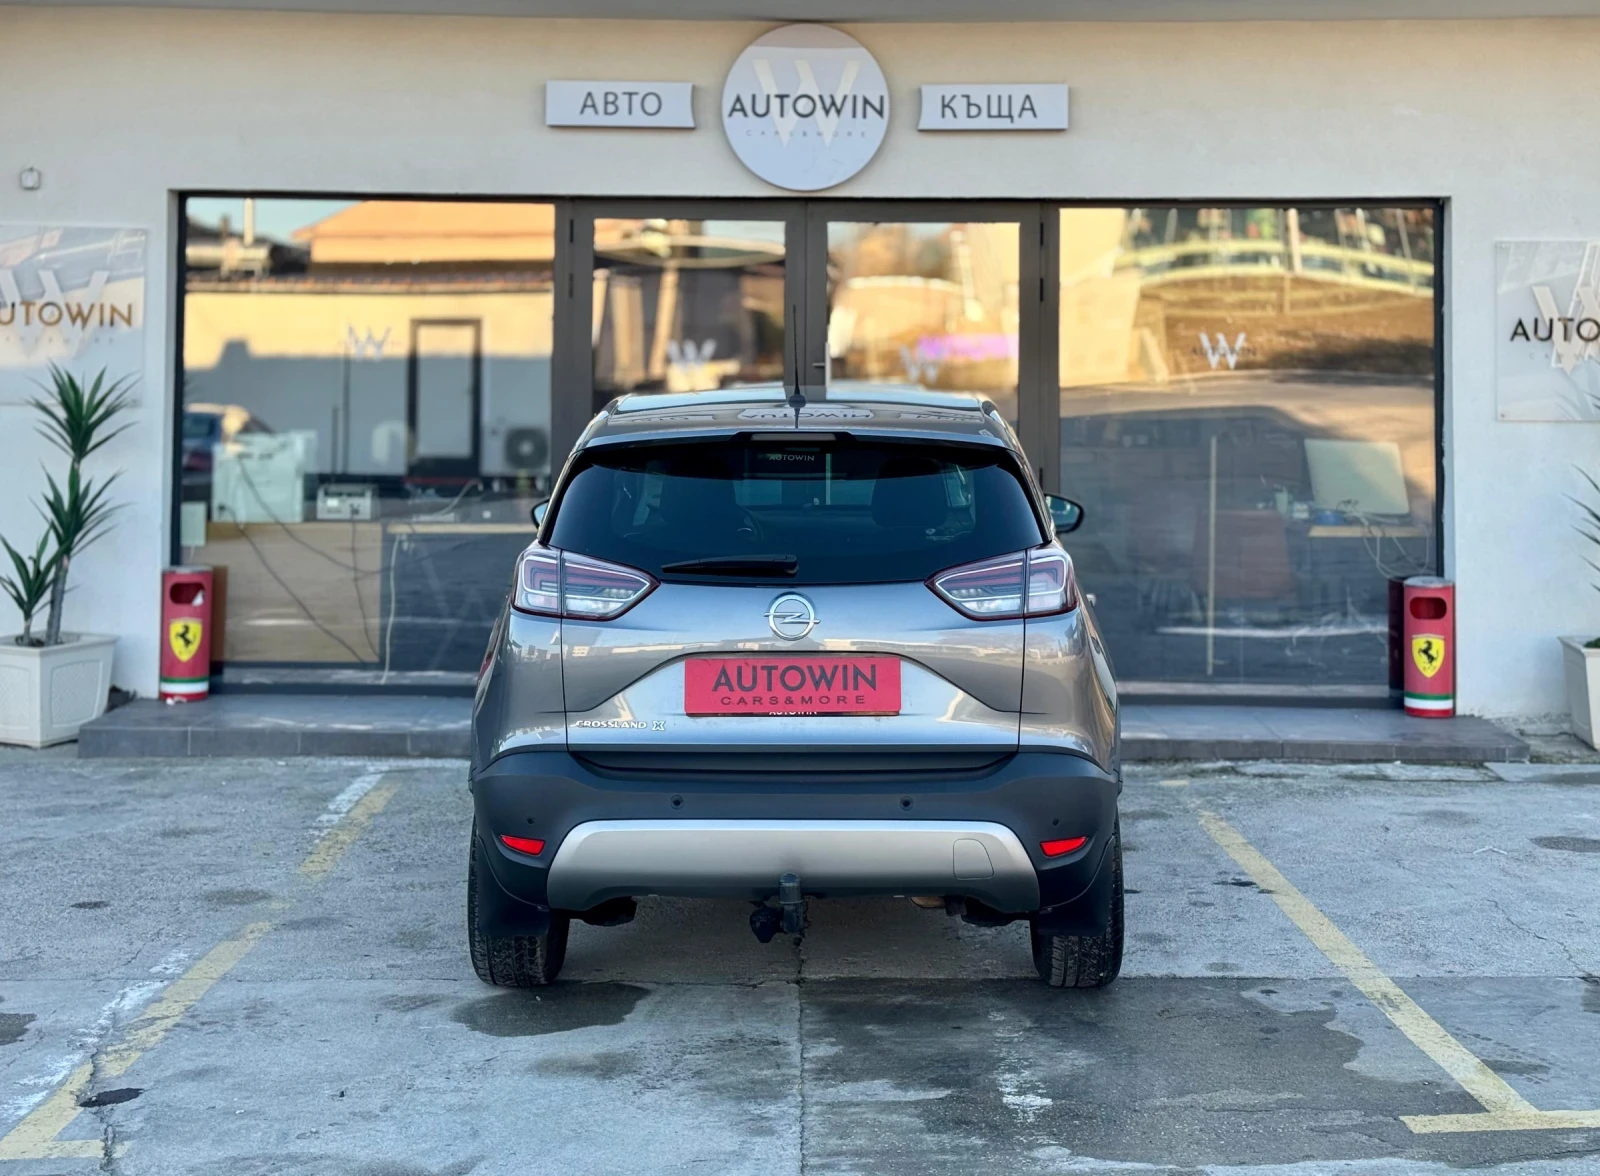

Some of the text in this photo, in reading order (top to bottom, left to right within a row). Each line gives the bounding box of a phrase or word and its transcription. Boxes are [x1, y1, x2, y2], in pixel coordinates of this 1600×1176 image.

[580, 91, 662, 116] АВТО
[727, 93, 885, 119] AUTOWIN
[941, 94, 1038, 124] КЪЩА
[769, 454, 815, 462] AUTOWIN
[712, 664, 877, 692] AUTOWIN
[720, 696, 866, 706] CARS&MORE
[575, 720, 666, 731] CROSSLAND X
